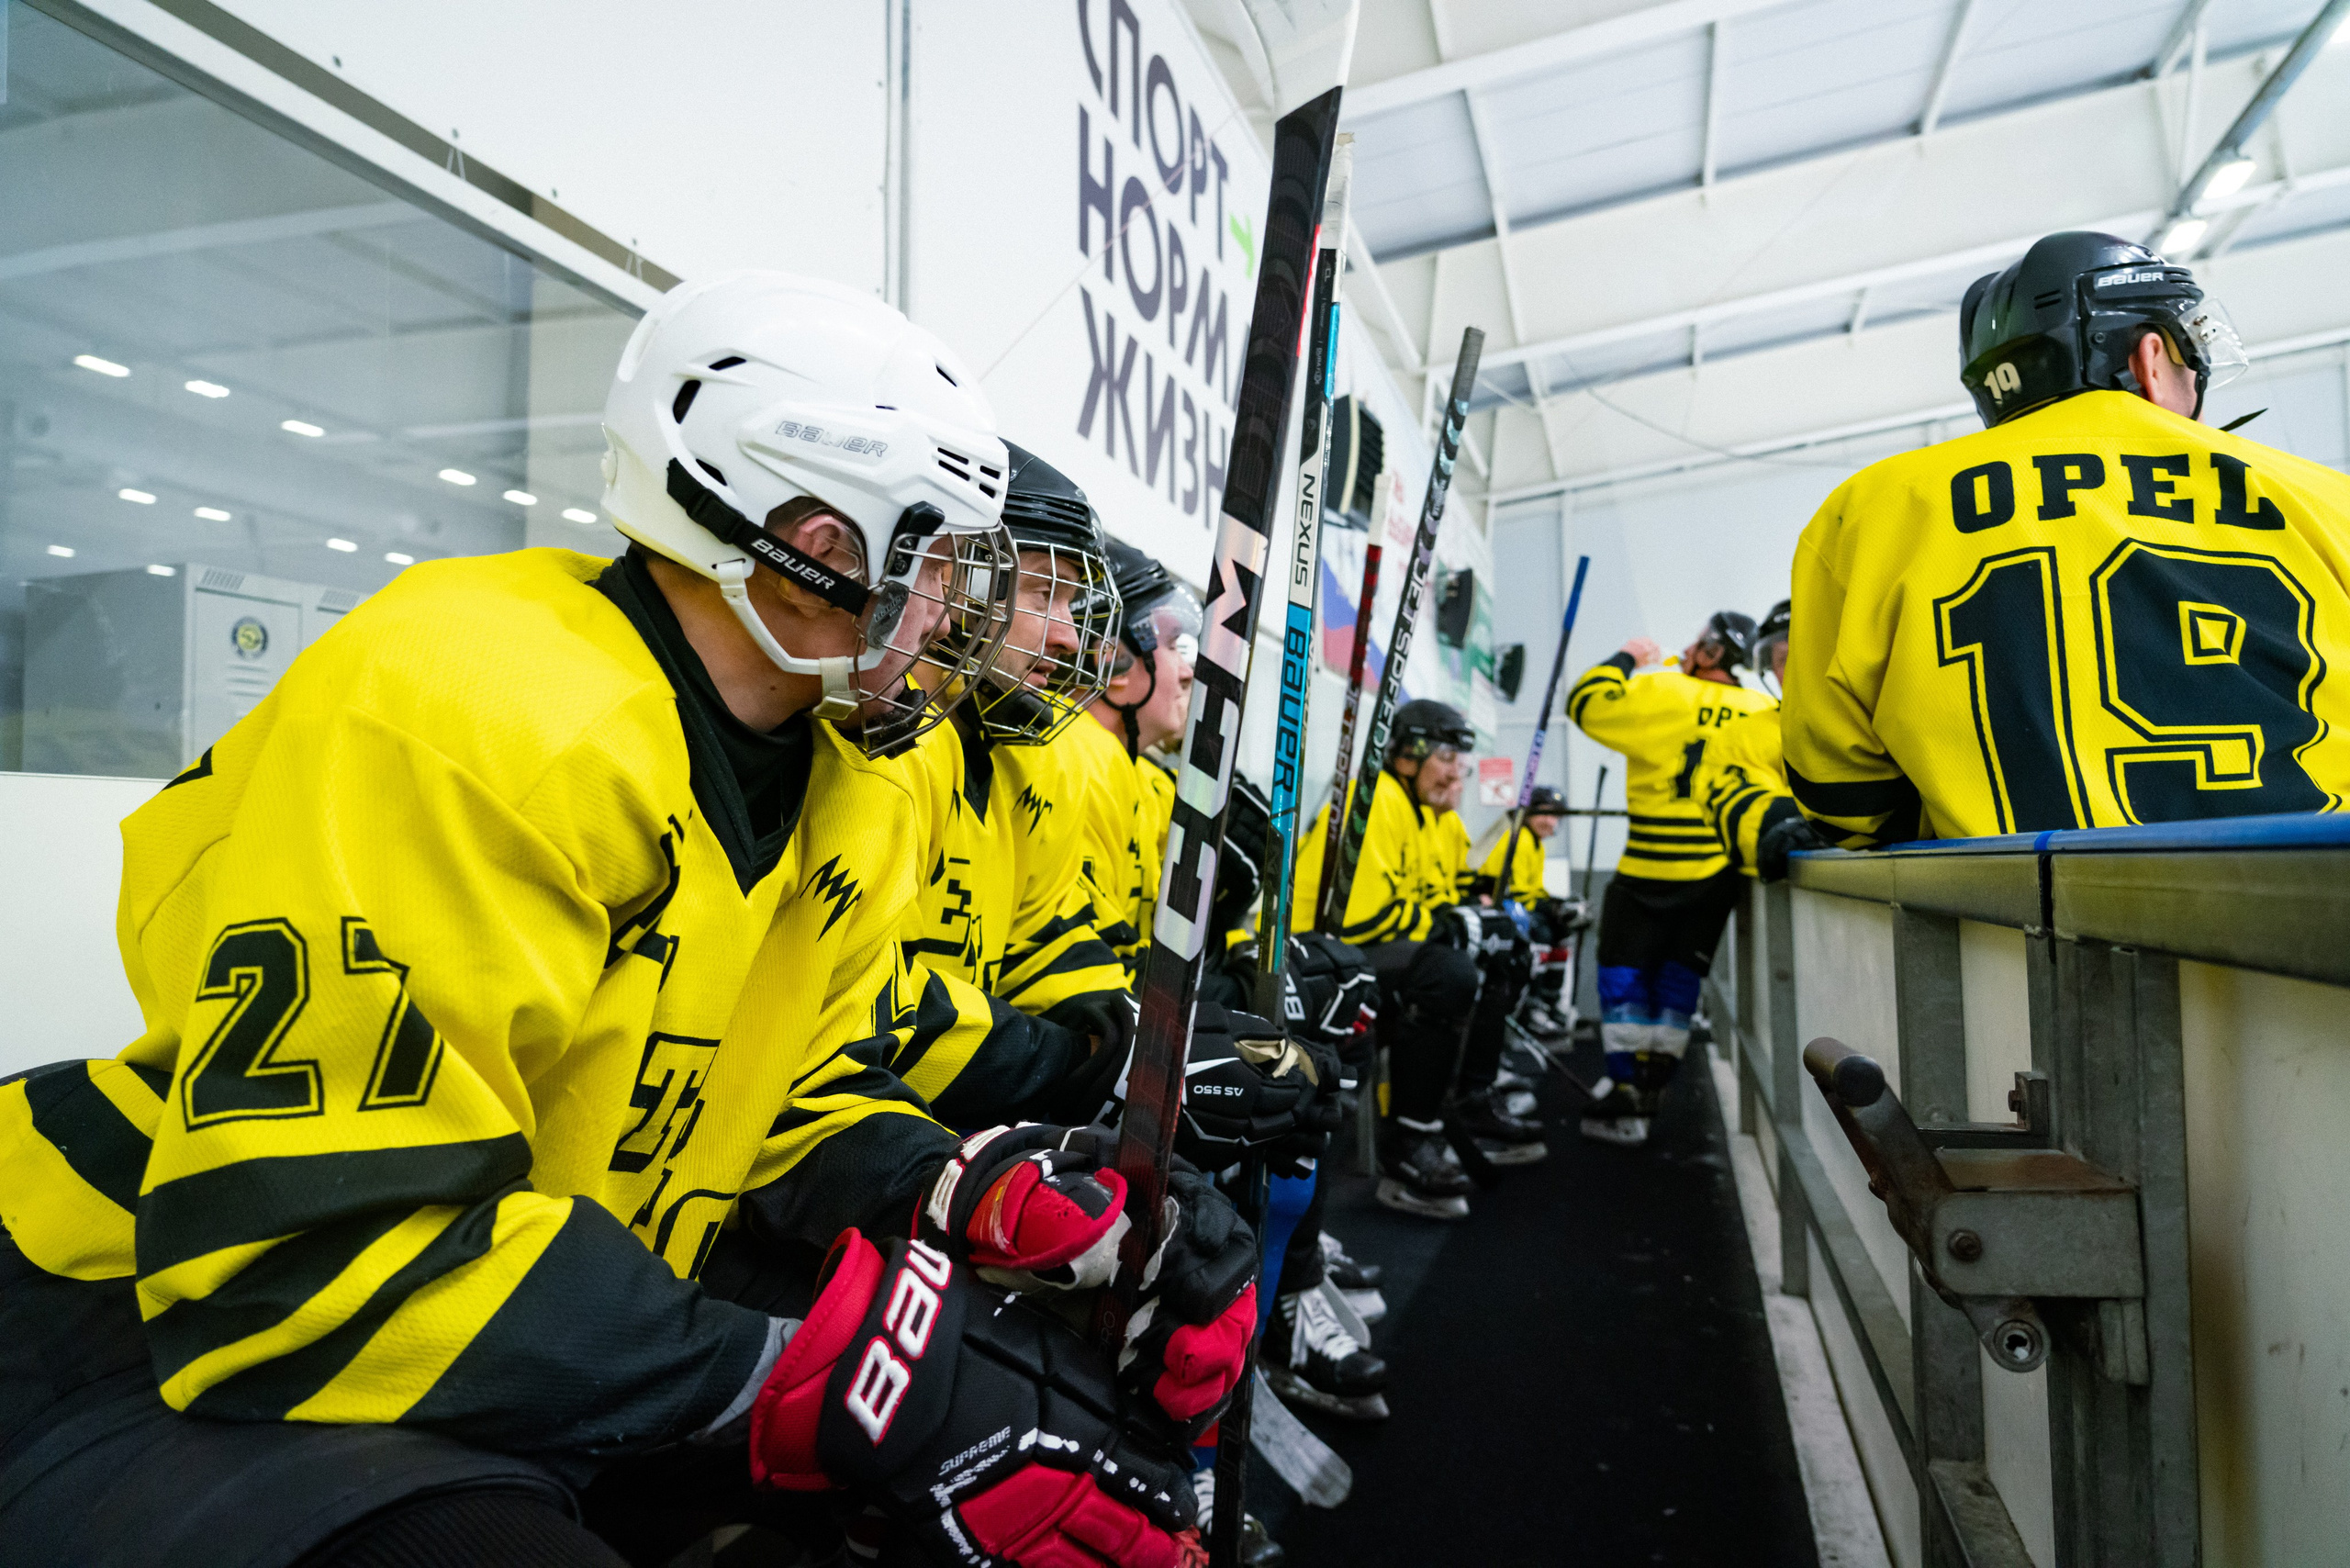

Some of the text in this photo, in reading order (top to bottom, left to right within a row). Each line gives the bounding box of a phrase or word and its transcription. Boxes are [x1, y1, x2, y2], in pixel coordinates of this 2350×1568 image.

[1080, 100, 1249, 417] НОРМ
[2098, 272, 2164, 287] BAUER
[776, 420, 888, 457] BAUER
[1077, 284, 1225, 532] ЖИЗН
[1983, 362, 2021, 406] 19
[1294, 473, 1315, 588] NEXUS
[1951, 453, 2286, 534] OPEL
[751, 538, 836, 590] BAUER
[1274, 626, 1305, 792] BAUER
[1373, 557, 1428, 749] JETSPEED
[1932, 536, 2342, 834] 19
[182, 916, 444, 1133] 27
[1193, 1085, 1244, 1097] AS 550
[845, 1238, 953, 1448] BAU
[938, 1426, 1011, 1476] SUPREME
